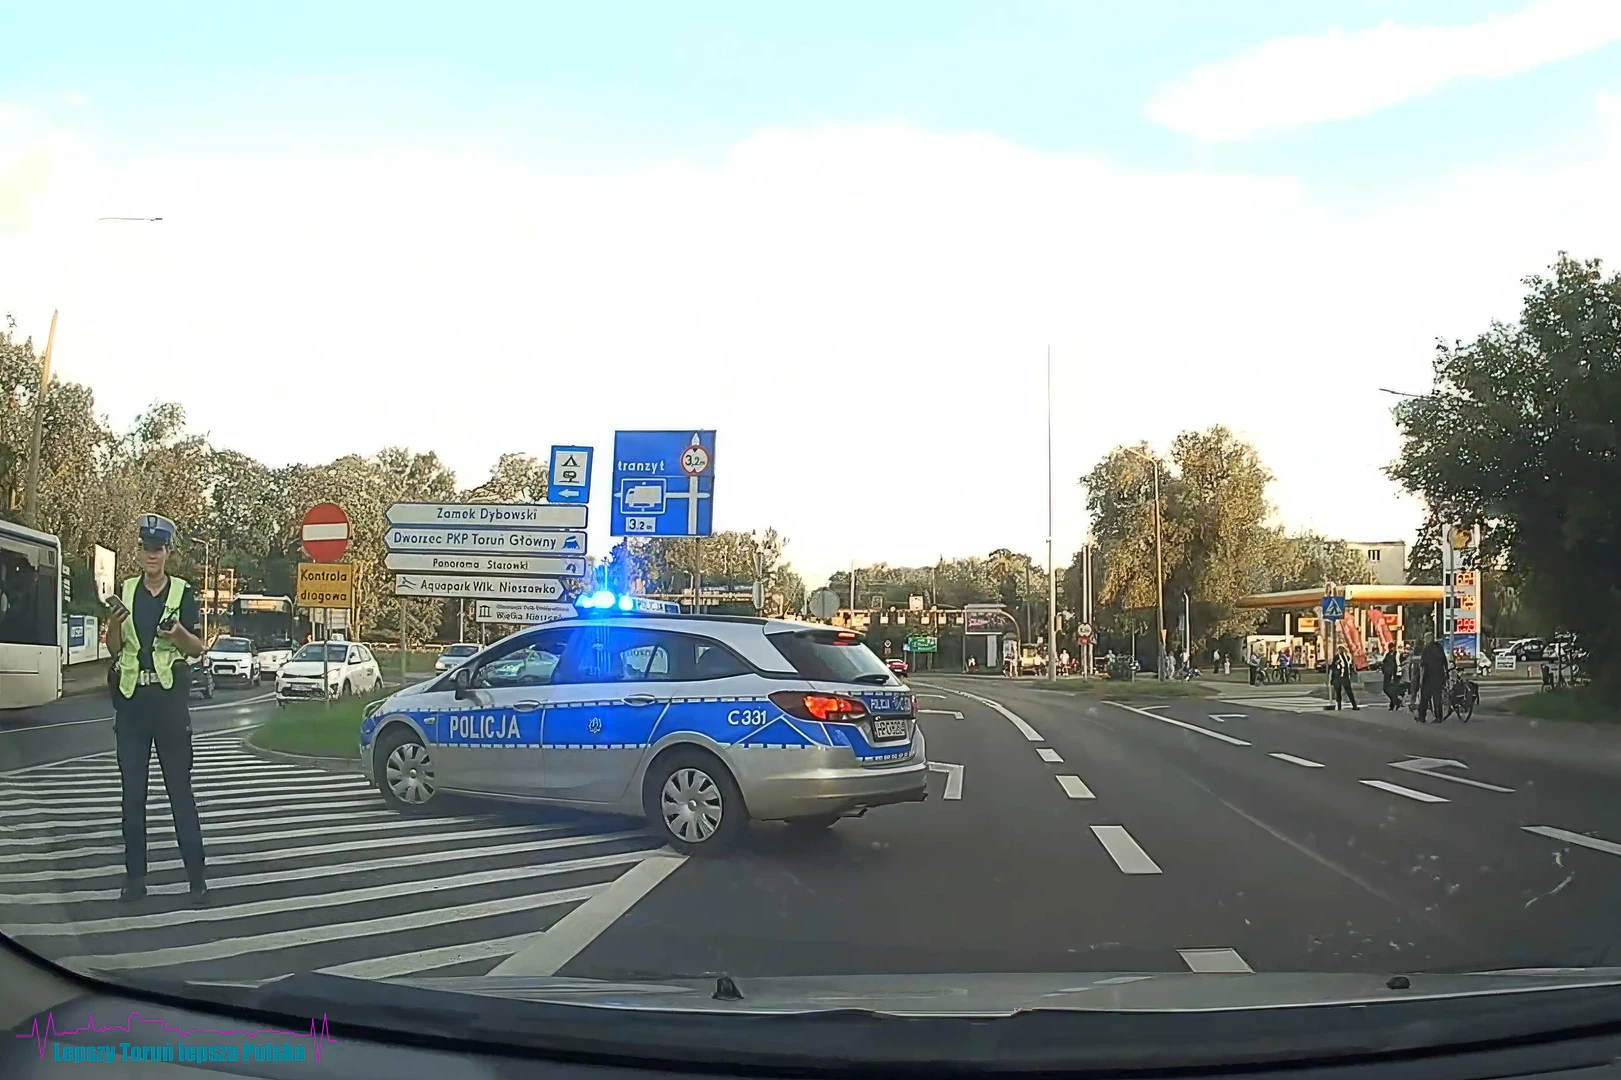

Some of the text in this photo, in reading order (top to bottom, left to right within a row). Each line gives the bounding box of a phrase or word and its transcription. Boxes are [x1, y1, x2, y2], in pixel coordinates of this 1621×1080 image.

[617, 460, 665, 474] tranzyt
[436, 507, 538, 522] Zamek Dybowski
[393, 532, 557, 550] Dworzec PKP Toruń Główny
[432, 558, 480, 569] Panorama
[300, 568, 347, 582] Kontrola
[420, 579, 470, 593] Aquapark
[499, 581, 556, 594] Nieszawka
[300, 590, 347, 604] drogowa
[449, 714, 521, 739] POLICJA
